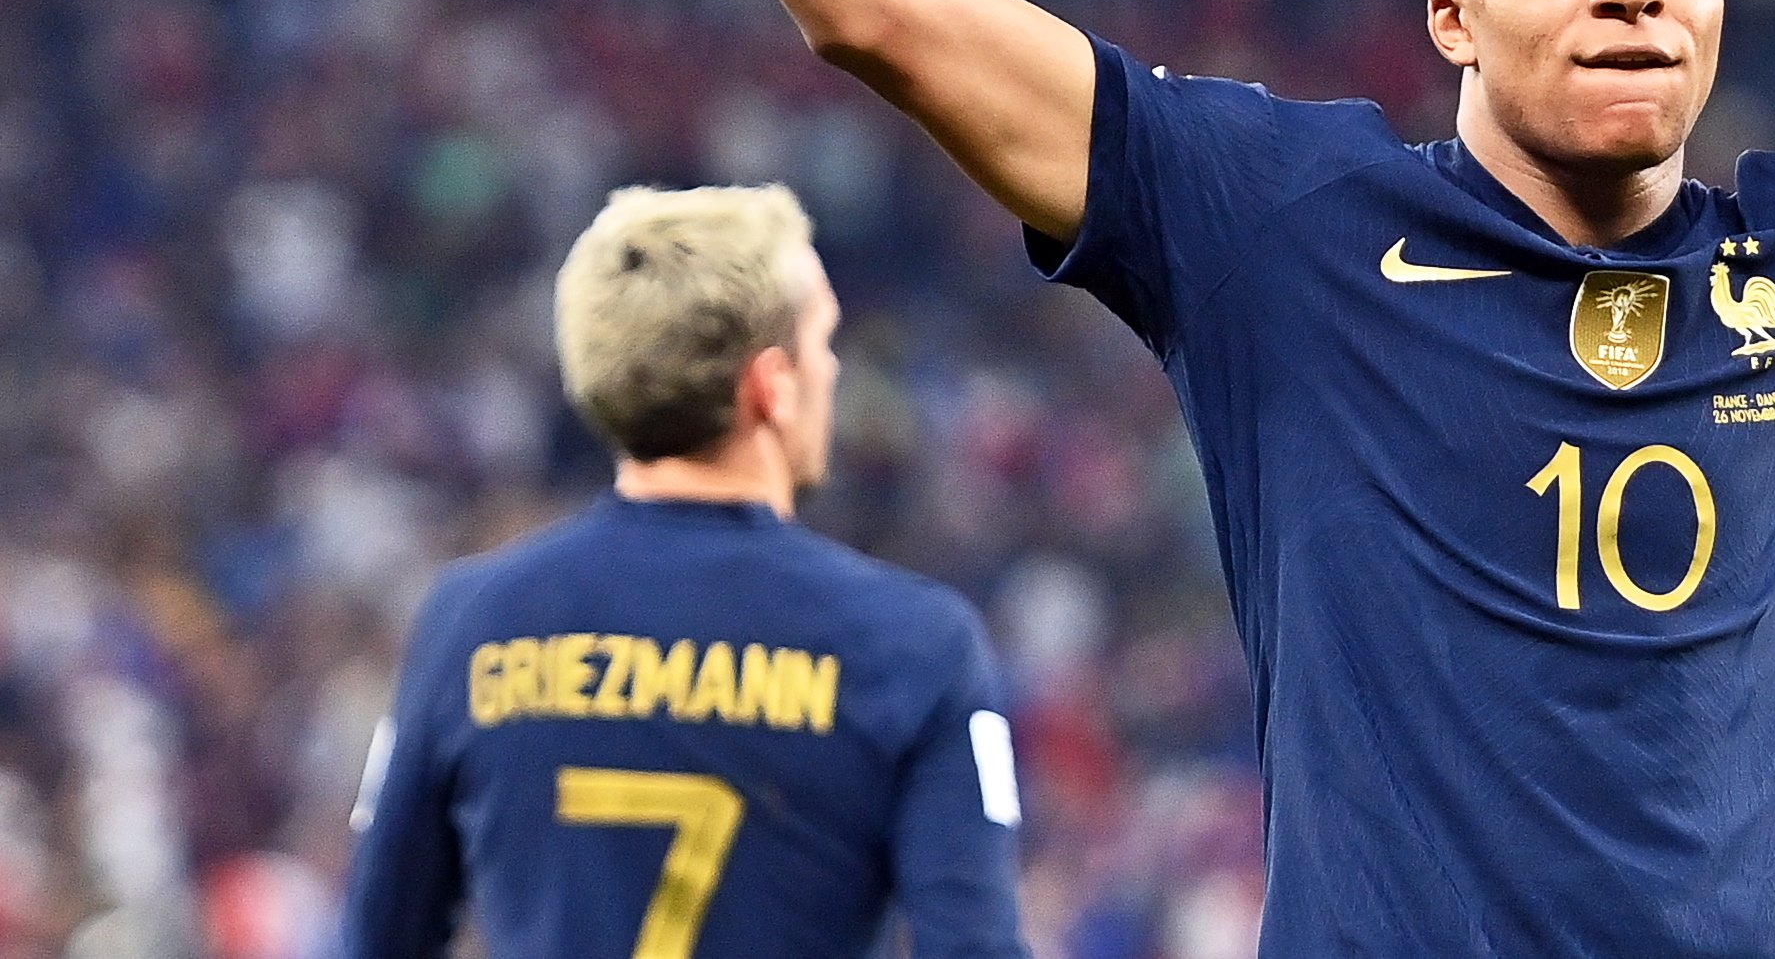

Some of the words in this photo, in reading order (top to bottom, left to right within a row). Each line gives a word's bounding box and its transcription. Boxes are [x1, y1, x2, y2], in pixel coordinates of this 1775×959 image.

[1598, 345, 1637, 361] FIFA
[1712, 394, 1748, 409] FRANCE
[1712, 409, 1729, 424] 26
[1525, 441, 1716, 611] 10
[469, 632, 841, 735] GRIEZMANN
[556, 767, 747, 959] 7
